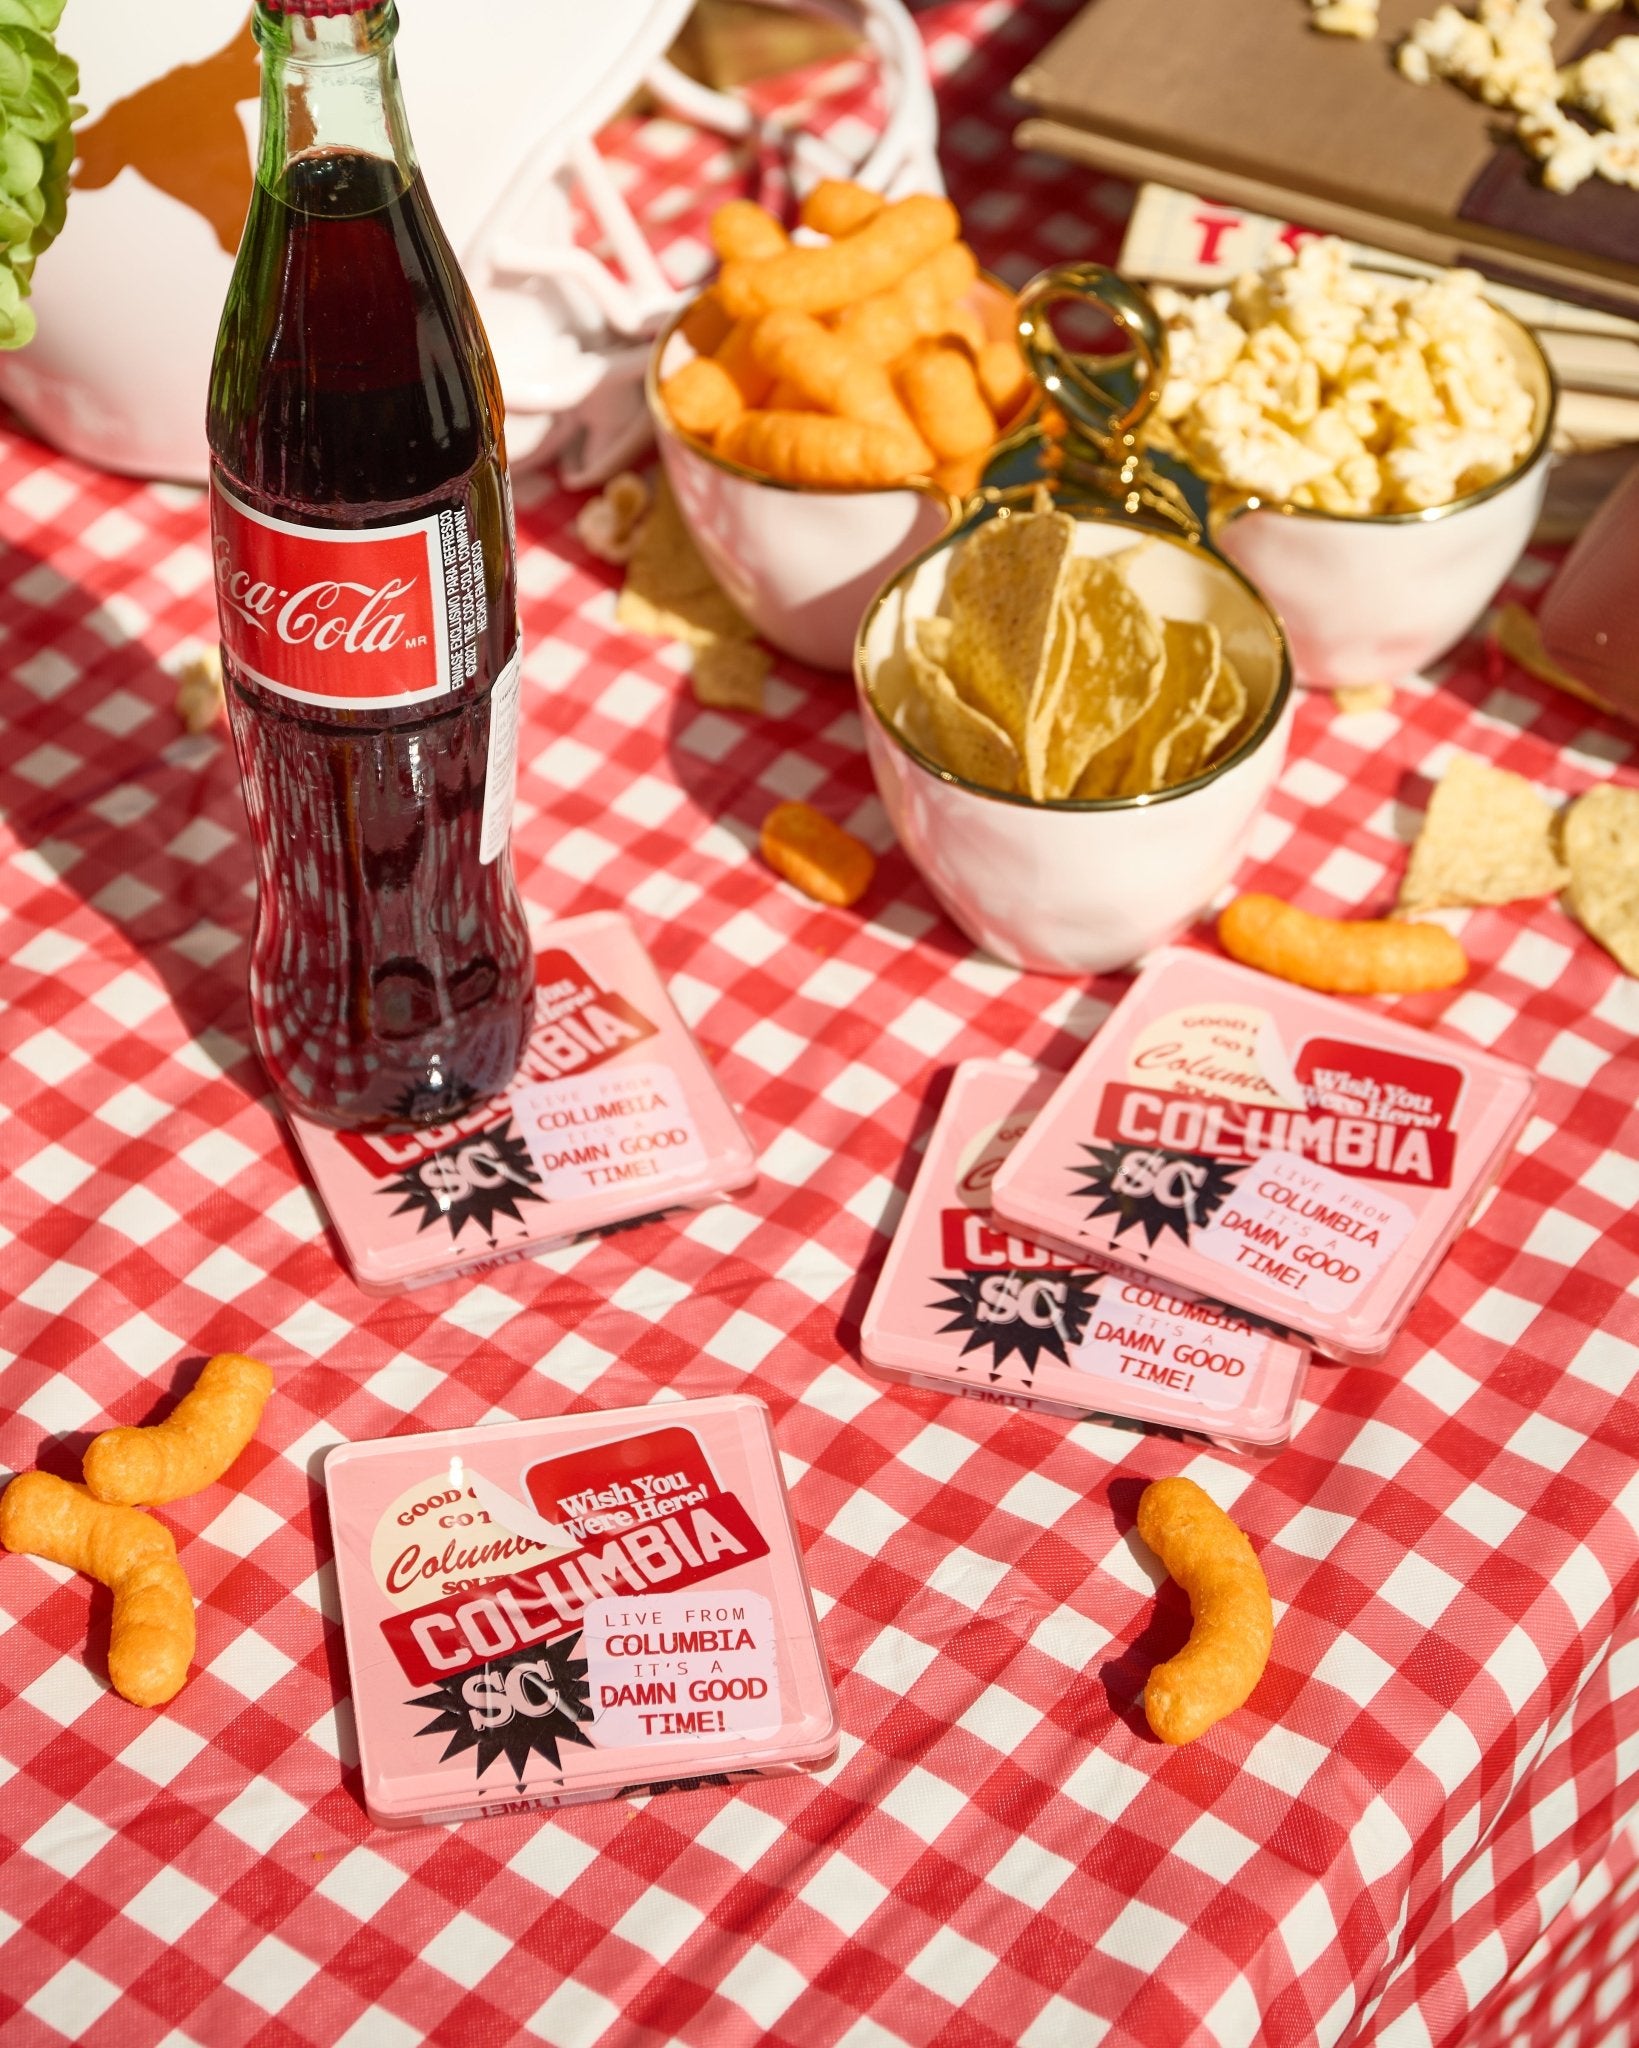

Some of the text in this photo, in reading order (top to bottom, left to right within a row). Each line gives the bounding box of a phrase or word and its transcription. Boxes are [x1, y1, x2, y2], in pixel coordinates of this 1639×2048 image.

[453, 505, 470, 562] COMPANY.
[470, 539, 485, 583] MEXICO
[439, 509, 465, 691] ENVASE EXCLUSIVO PARA REFRESCO
[460, 559, 475, 621] COCA-COLA
[463, 618, 476, 644] THE
[475, 596, 488, 634] HECHO
[404, 635, 428, 650] MR
[537, 1093, 668, 1131] COLUMBIA
[1312, 1067, 1434, 1113] Wish You
[542, 1128, 688, 1171] DAMN GOOD
[1116, 1091, 1434, 1182] COLUMBIA
[1110, 1150, 1210, 1209] SC
[1274, 1164, 1392, 1225] LIVE FROM
[1257, 1180, 1380, 1249] COLUMBIA
[1220, 1209, 1361, 1284] DAMN GOOD
[1236, 1244, 1309, 1290] TIME!
[1325, 1239, 1339, 1251] A
[976, 1274, 1068, 1329] SC
[1094, 1321, 1245, 1378] DAMN GOOD
[1202, 1334, 1215, 1346] A
[1120, 1354, 1195, 1392] TIME!
[396, 1488, 462, 1527] GOOD
[557, 1471, 692, 1519] Wish You
[561, 1482, 710, 1541] Were Here!
[438, 1512, 474, 1529] GO
[409, 1507, 749, 1672] COLUMBIA
[604, 1606, 746, 1628] LIVE FROM
[605, 1628, 757, 1658] COLUMBIA
[633, 1660, 724, 1678] IT'S A
[461, 1658, 561, 1732] SC
[599, 1677, 769, 1709] DAMN GOOD
[638, 1710, 726, 1736] TIME!
